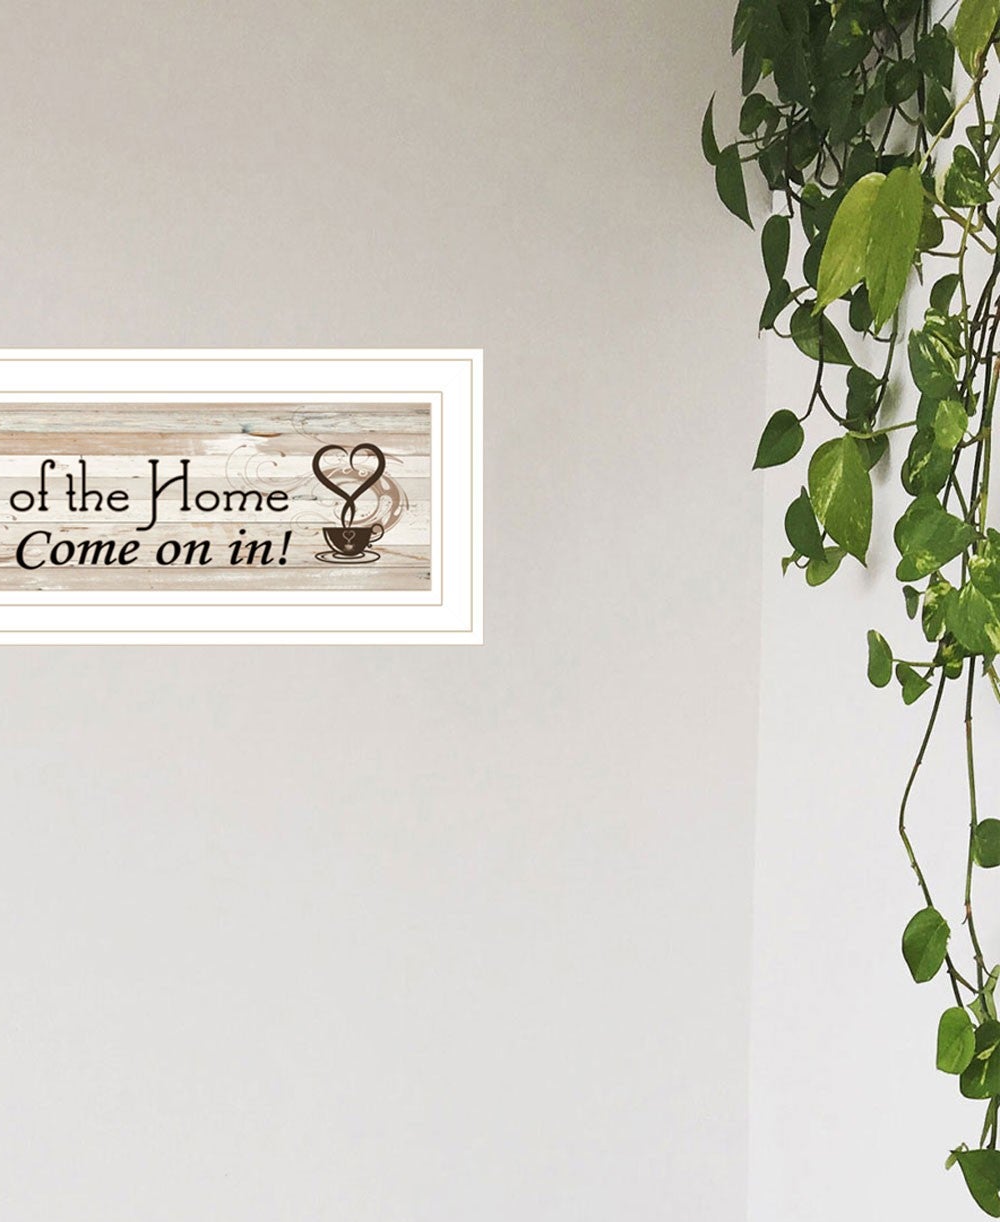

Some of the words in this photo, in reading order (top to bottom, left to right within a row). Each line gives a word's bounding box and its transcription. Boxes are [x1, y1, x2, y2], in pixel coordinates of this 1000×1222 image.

[9, 459, 56, 512] of
[66, 459, 129, 512] the
[135, 459, 289, 532] Home
[15, 530, 140, 570] Come
[156, 540, 213, 566] on
[228, 530, 292, 566] in!
